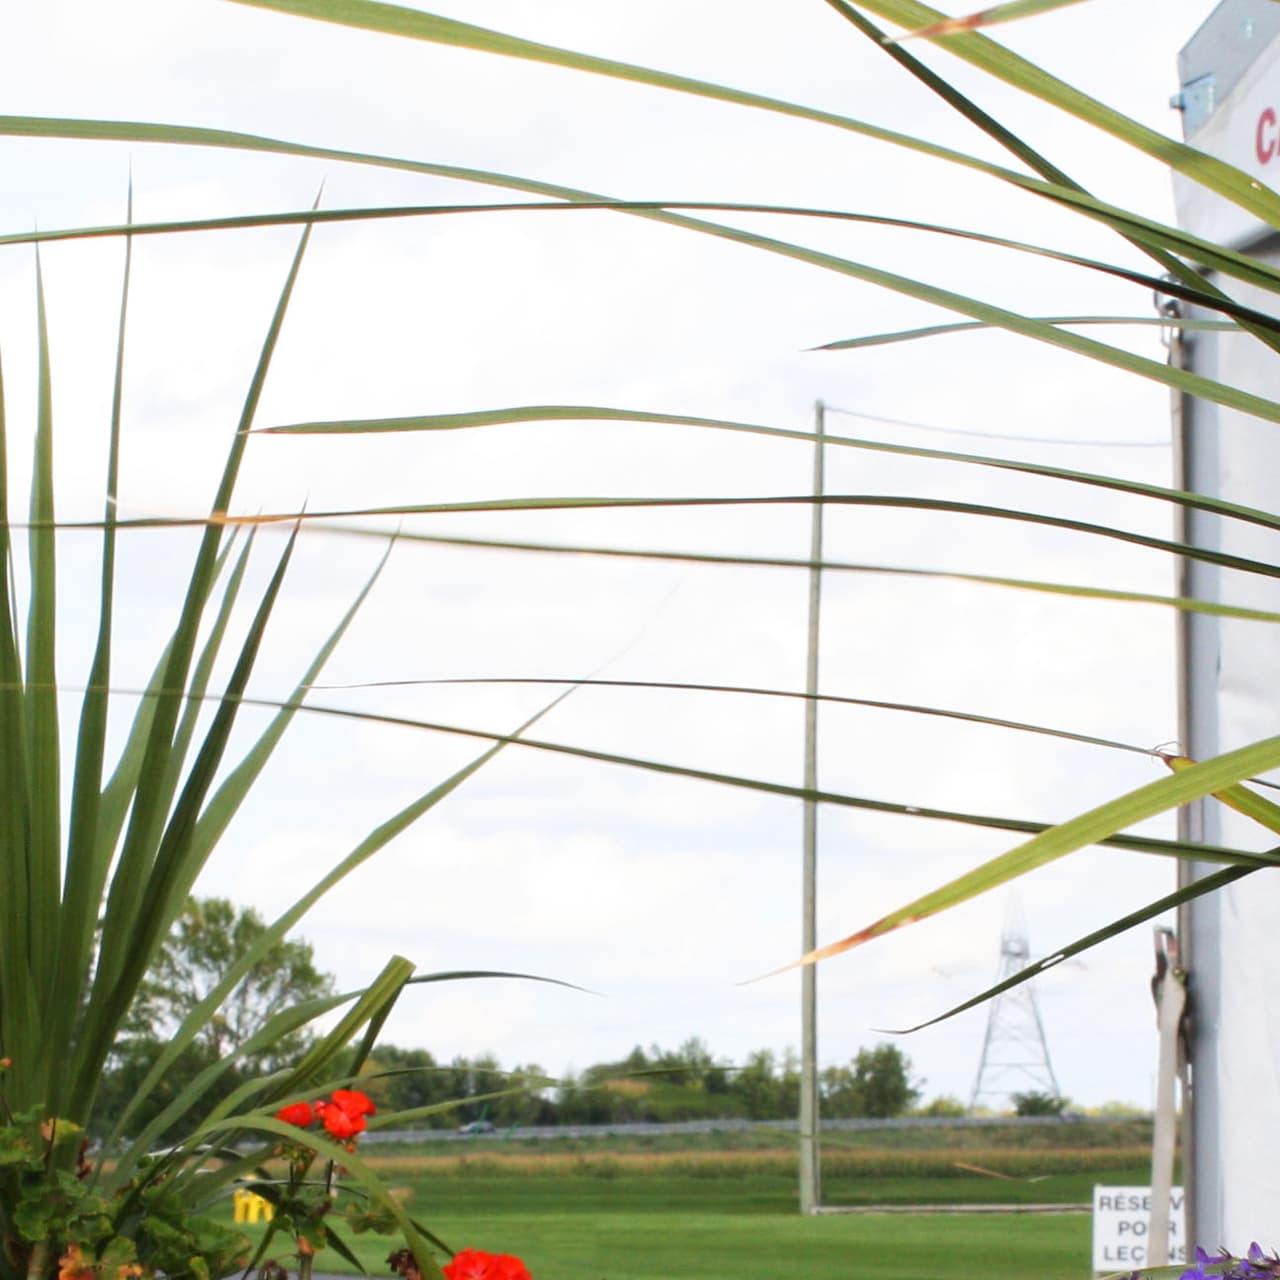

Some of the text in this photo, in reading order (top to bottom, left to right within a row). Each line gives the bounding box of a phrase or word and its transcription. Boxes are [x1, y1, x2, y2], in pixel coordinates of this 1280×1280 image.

[1099, 1192, 1184, 1211] RÉSEV
[1118, 1221, 1177, 1236] POR
[1104, 1245, 1187, 1264] LEÇNS
